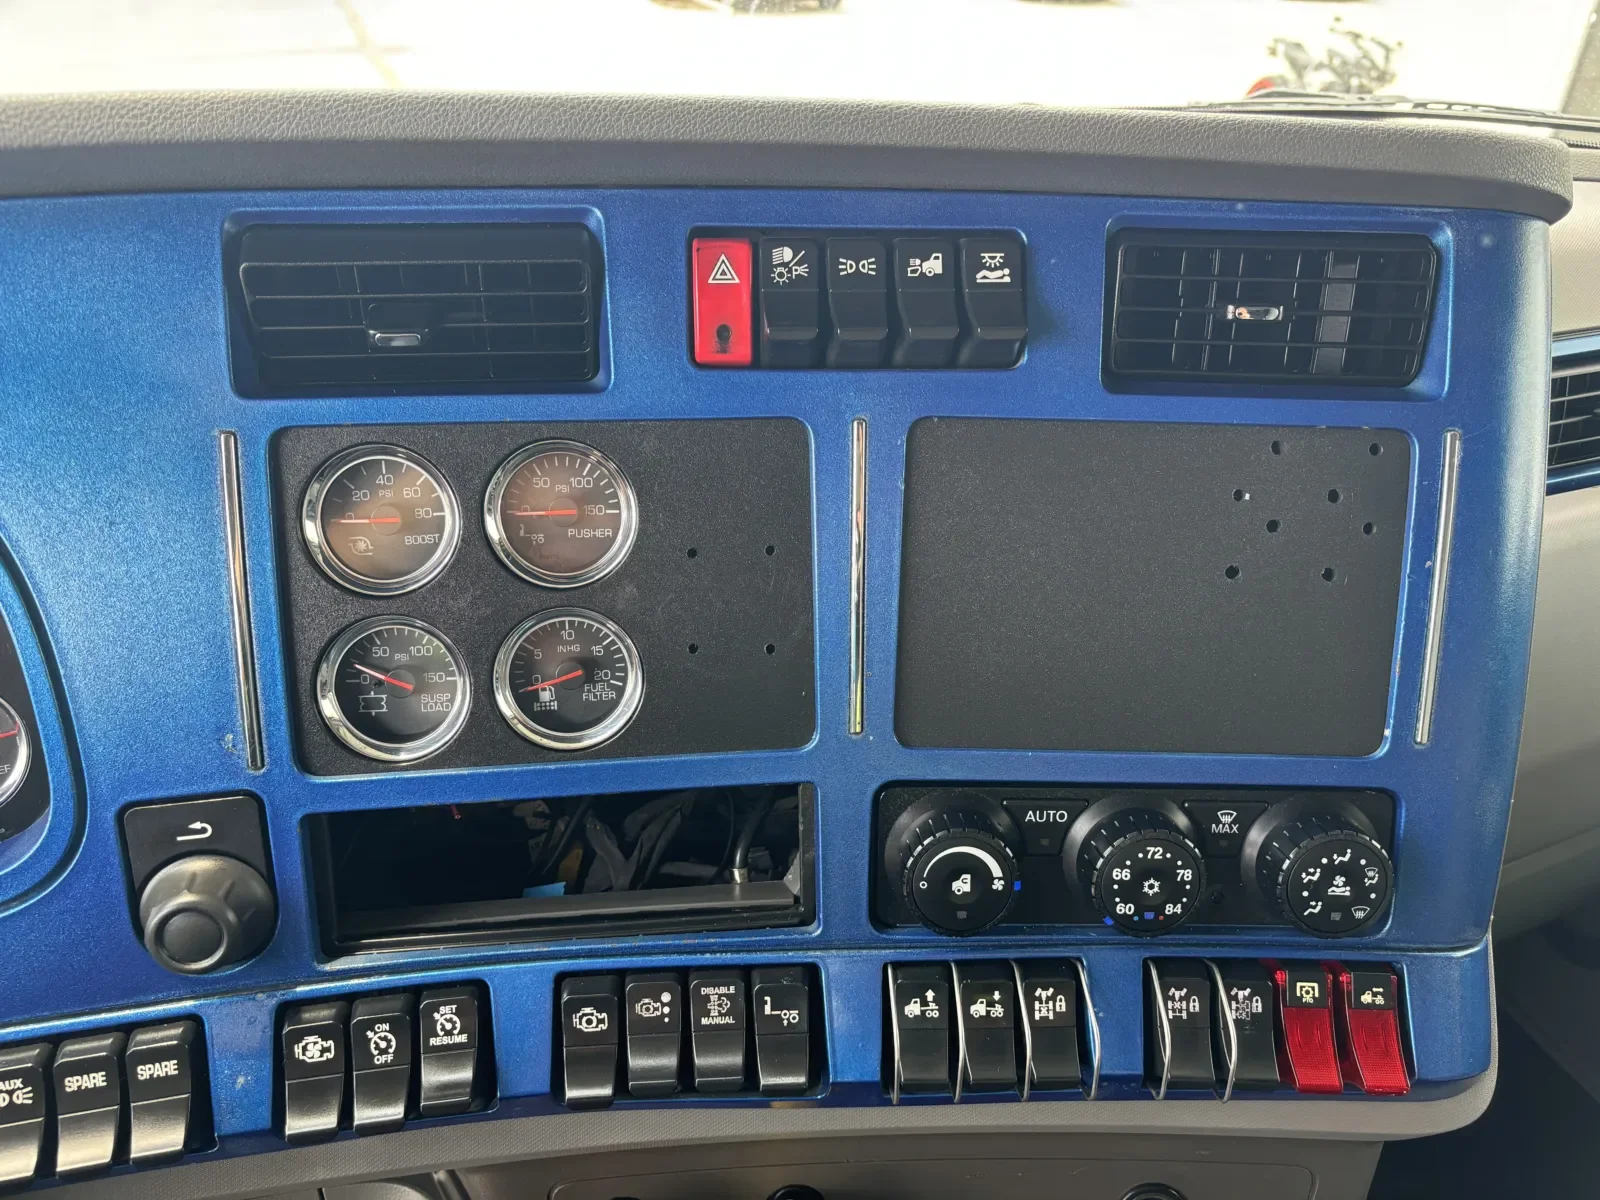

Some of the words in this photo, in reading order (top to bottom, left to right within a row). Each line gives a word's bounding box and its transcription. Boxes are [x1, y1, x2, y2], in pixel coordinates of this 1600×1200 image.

[376, 475, 393, 485] 40
[533, 477, 550, 488] 50
[570, 478, 593, 488] 100
[352, 490, 370, 500] 20
[403, 487, 420, 498] 60
[414, 508, 432, 518] 80
[583, 505, 605, 515] 150
[568, 528, 612, 538] PUSHER
[405, 534, 440, 545] BOOST
[560, 630, 574, 640] 10
[372, 646, 389, 657] 50
[409, 646, 433, 656] 100
[534, 649, 542, 659] 5
[591, 646, 603, 656] 15
[361, 674, 370, 684] 0
[423, 672, 445, 682] 150
[532, 675, 542, 685] 0
[594, 670, 610, 680] 20
[585, 683, 610, 692] FUEL
[421, 694, 451, 702] SUSP
[583, 692, 616, 701] FILTER
[422, 703, 451, 712] LOAD
[1025, 810, 1068, 823] AUTO
[1211, 824, 1238, 834] MAX
[1146, 847, 1163, 859] 72
[1112, 868, 1131, 880] 66
[1176, 870, 1192, 881] 78
[1116, 903, 1134, 915] 60
[1165, 903, 1182, 915] 84
[701, 986, 736, 994] DISABLE
[439, 1005, 457, 1014] SET
[701, 1016, 735, 1025] MANUAL
[375, 1023, 389, 1032] ON
[430, 1034, 468, 1046] RESUME
[374, 1055, 394, 1064] OFF
[137, 1060, 178, 1080] SPARE
[0, 1078, 24, 1090] AUX
[64, 1072, 107, 1092] SPARE
